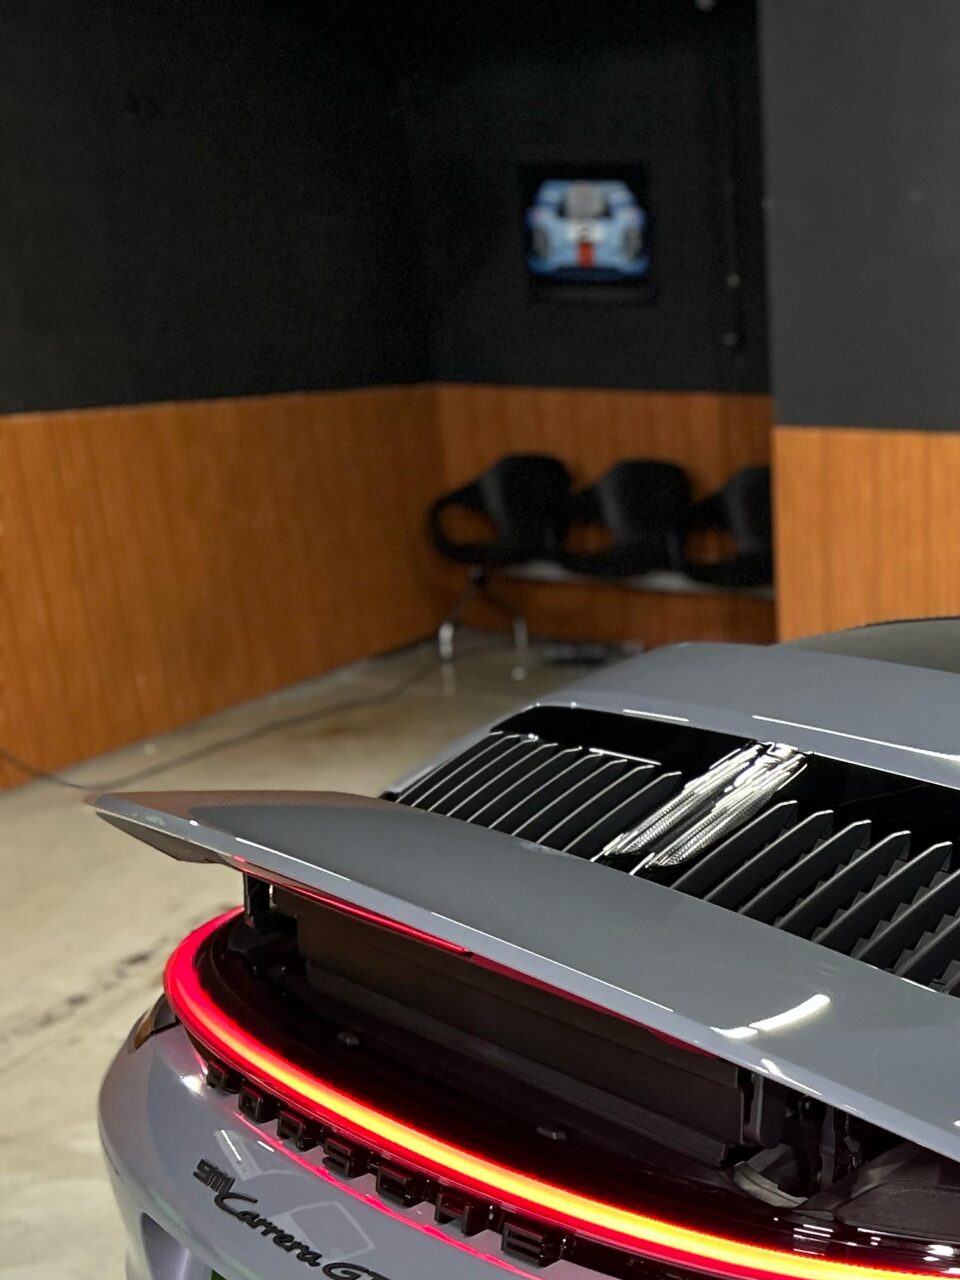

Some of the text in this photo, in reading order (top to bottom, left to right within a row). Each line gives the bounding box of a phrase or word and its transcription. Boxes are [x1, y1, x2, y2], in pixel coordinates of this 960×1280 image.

[192, 1158, 236, 1194] 911
[214, 1192, 322, 1268] Carrera
[205, 1058, 552, 1270] PORSCHE
